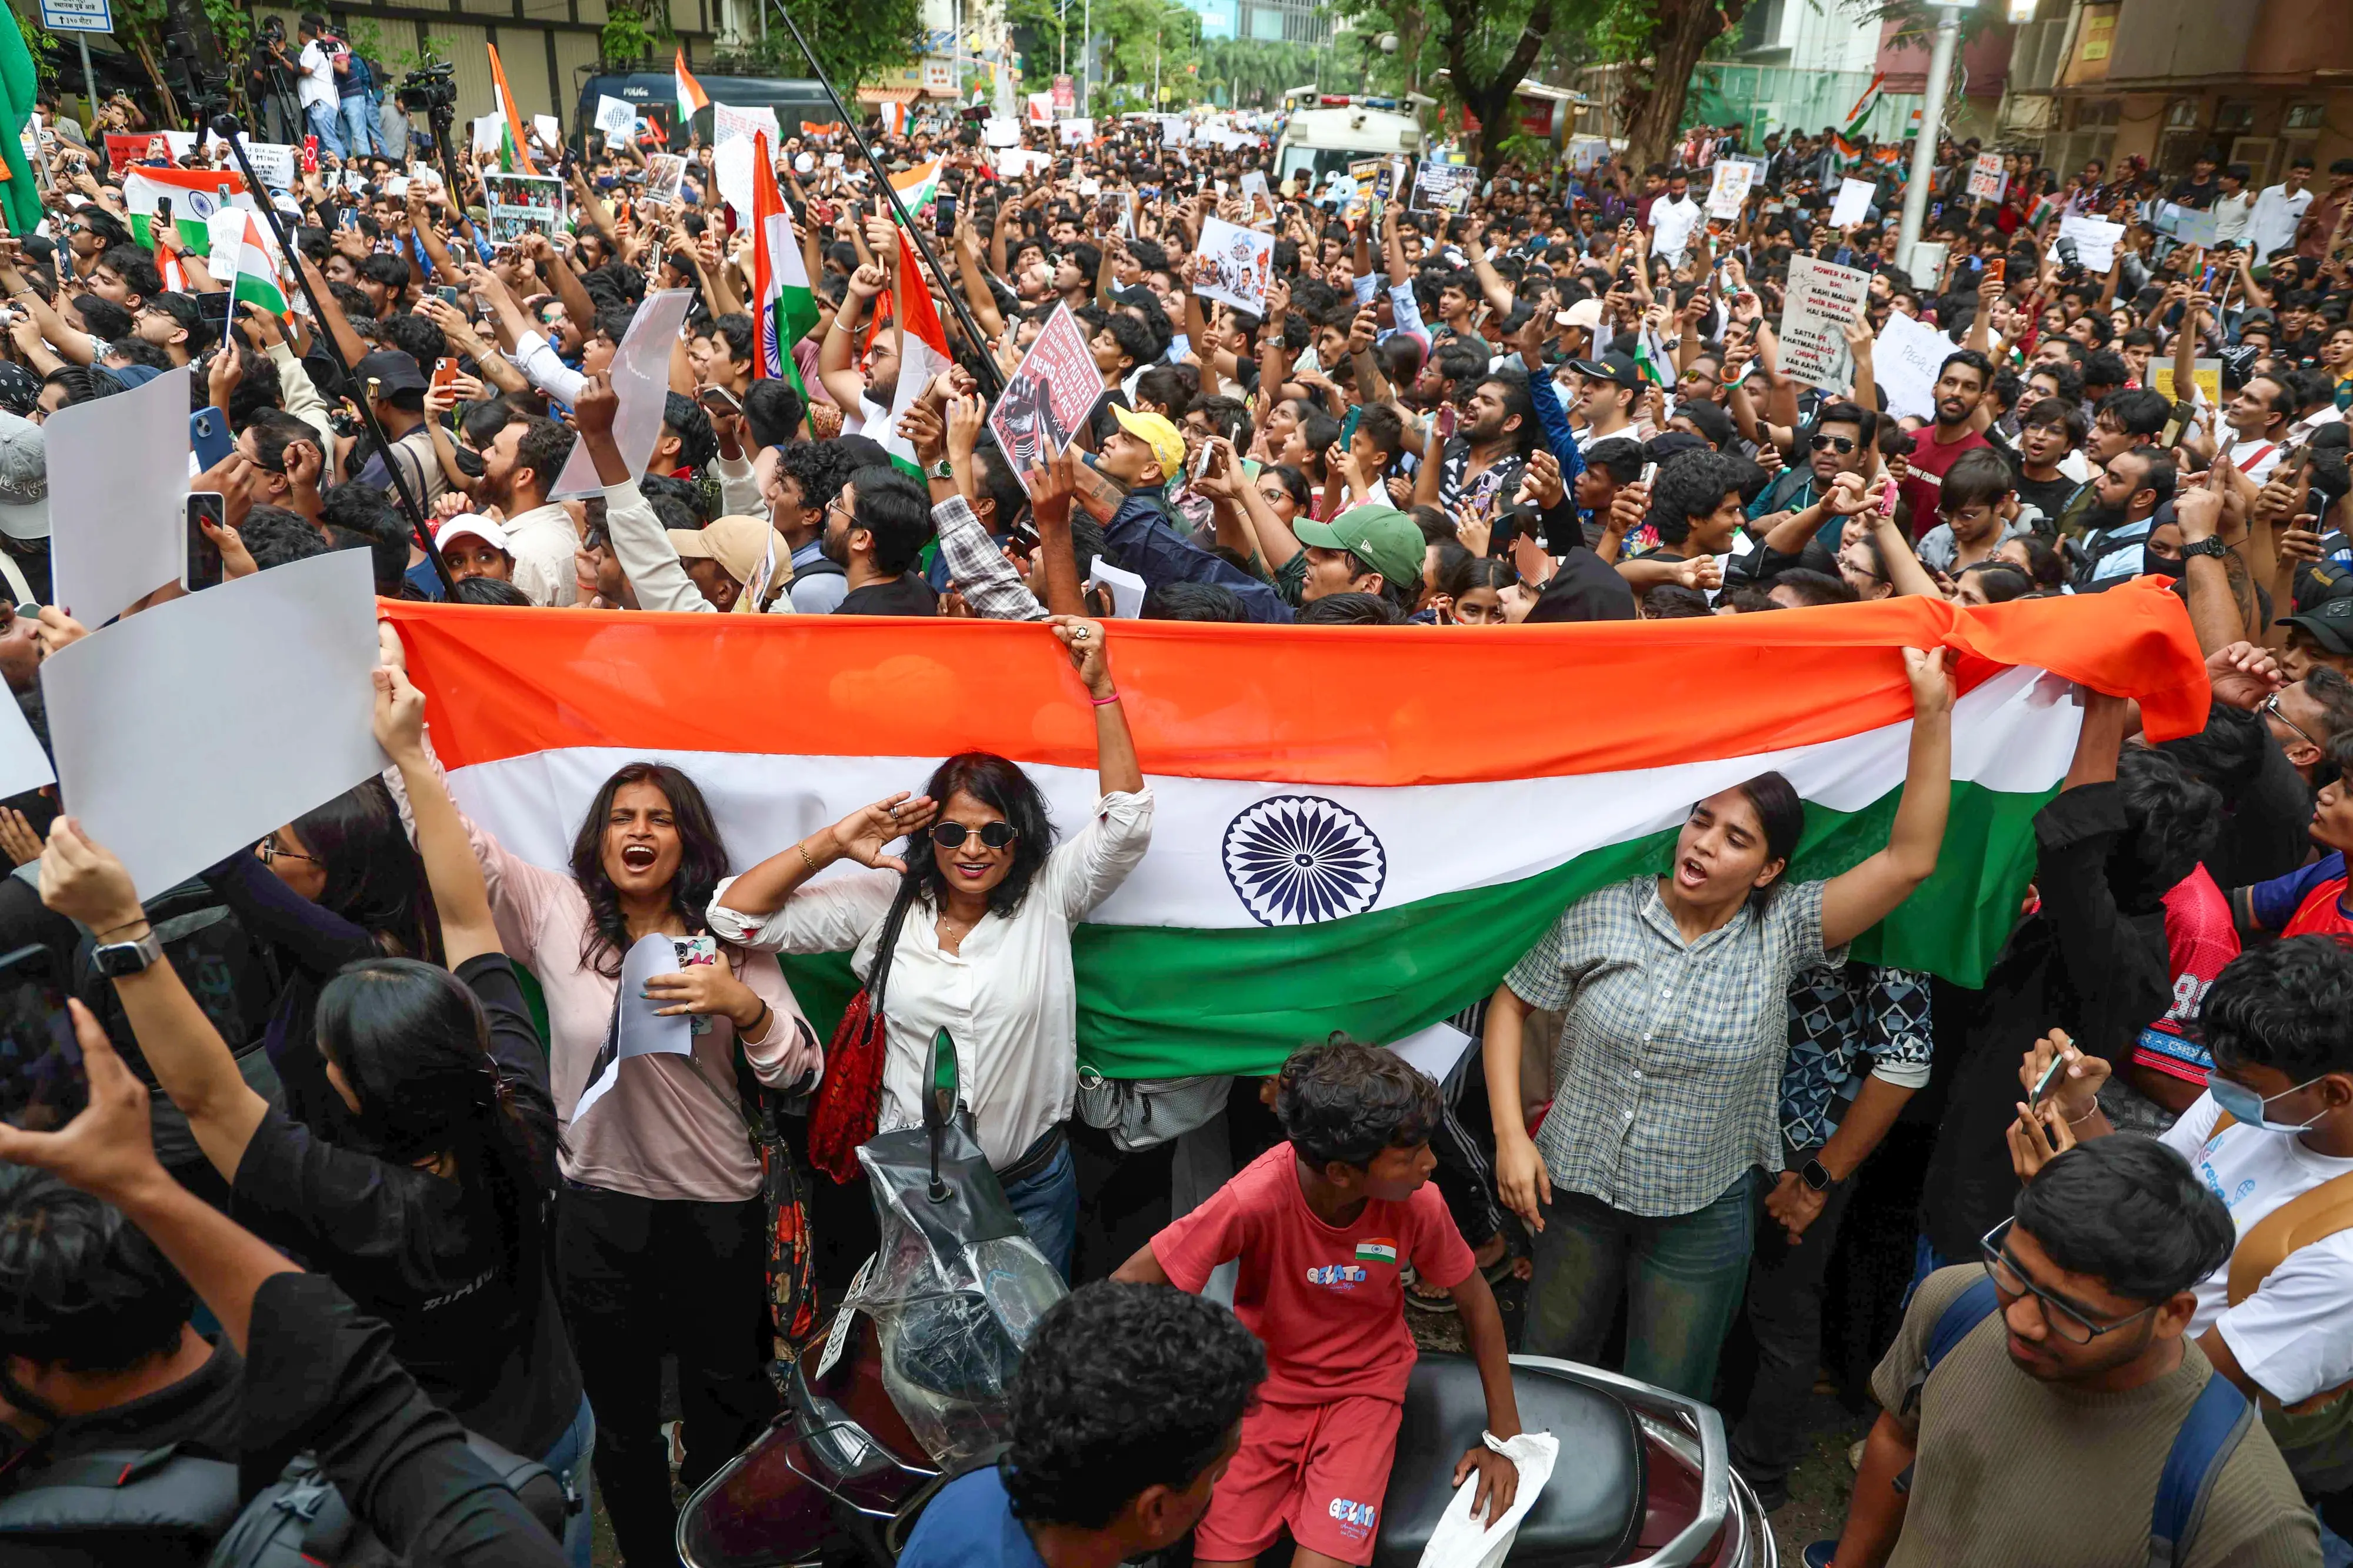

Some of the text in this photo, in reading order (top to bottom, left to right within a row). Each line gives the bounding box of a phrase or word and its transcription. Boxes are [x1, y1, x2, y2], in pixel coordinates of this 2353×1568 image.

[79, 16, 92, 25] मीटर
[1813, 265, 1839, 277] POWER
[1841, 272, 1851, 281] KA
[1829, 281, 1842, 289] BHI
[1808, 297, 1826, 306] PHIR
[1827, 301, 1840, 311] BHI
[1831, 292, 1857, 304] MALUM
[1807, 307, 1819, 316] HAI
[1794, 328, 1816, 339] SATTA
[1058, 313, 1097, 391] A GOVERNMENT THAT
[1046, 329, 1093, 406] TOLERATE PROTEST
[1785, 356, 1799, 366] KAB
[1902, 345, 1937, 377] PEOPLE
[1058, 361, 1084, 415] TOLERATE
[1307, 1265, 1366, 1285] GELATO
[1329, 1497, 1375, 1527] GELATO
